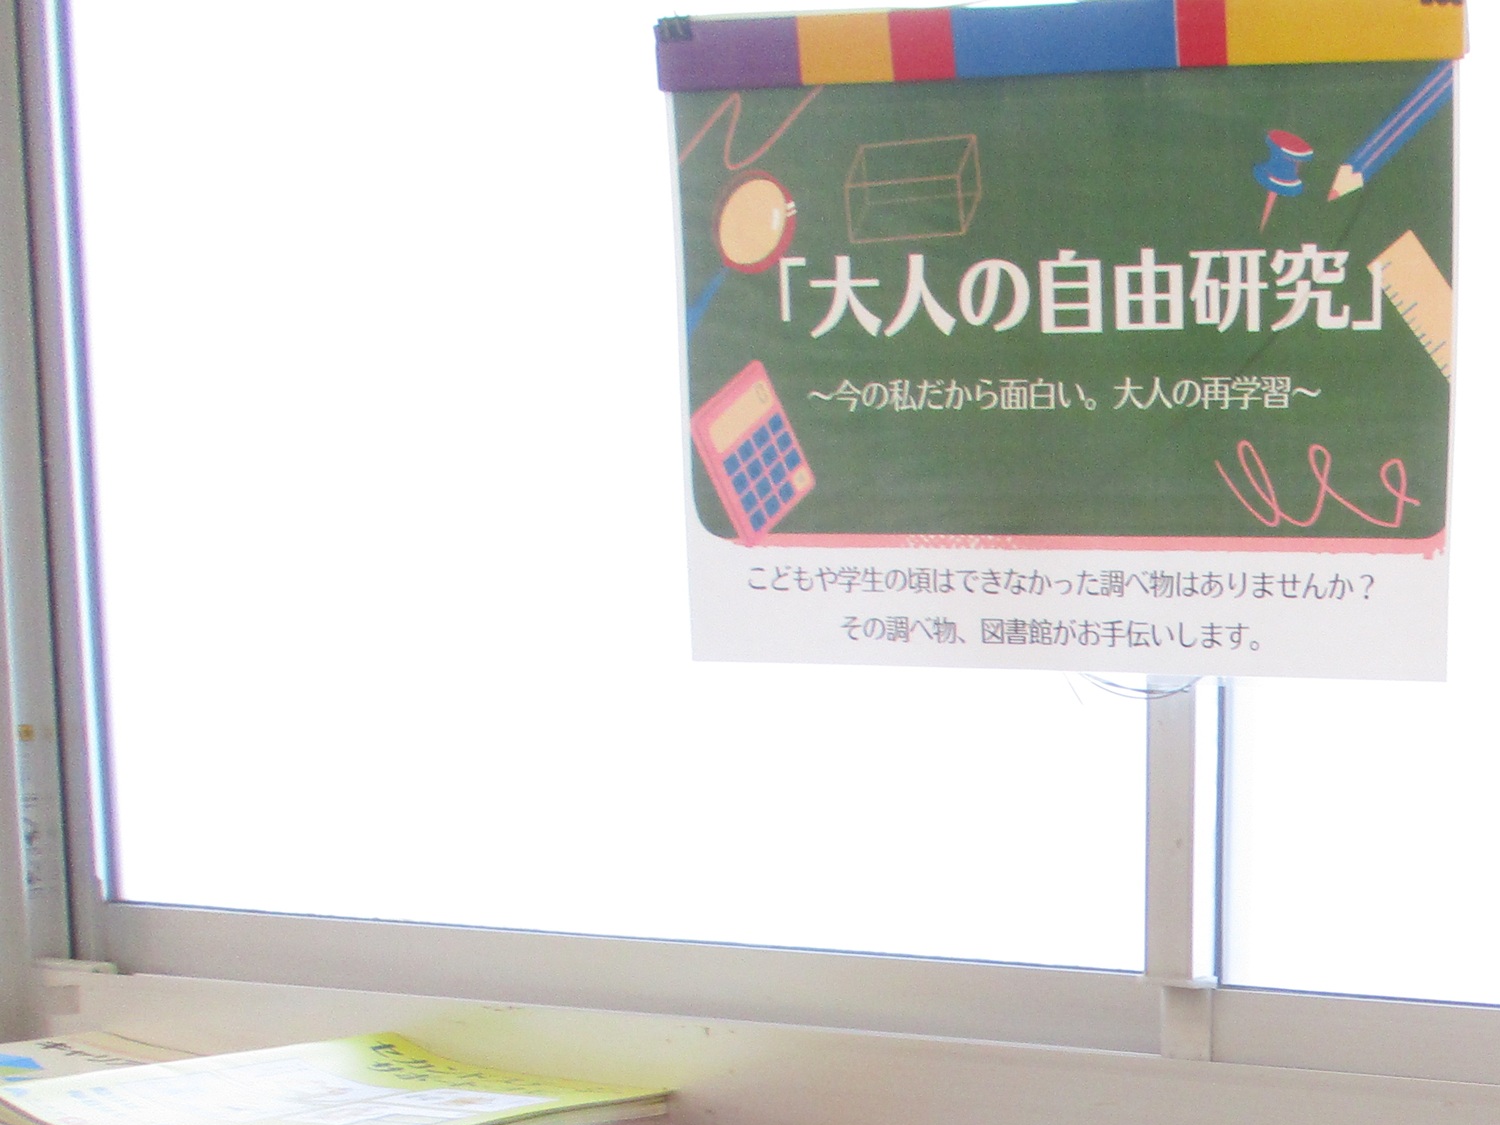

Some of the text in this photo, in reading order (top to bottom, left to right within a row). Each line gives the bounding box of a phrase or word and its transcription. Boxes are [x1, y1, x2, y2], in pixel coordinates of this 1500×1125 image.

[776, 245, 1385, 337] 「大人の自由研究」
[747, 565, 1376, 601] こどもや学生の頃はできなかった調べ物はありませんか？
[841, 616, 1262, 652] その調べ物、図書館がお手伝いします。
